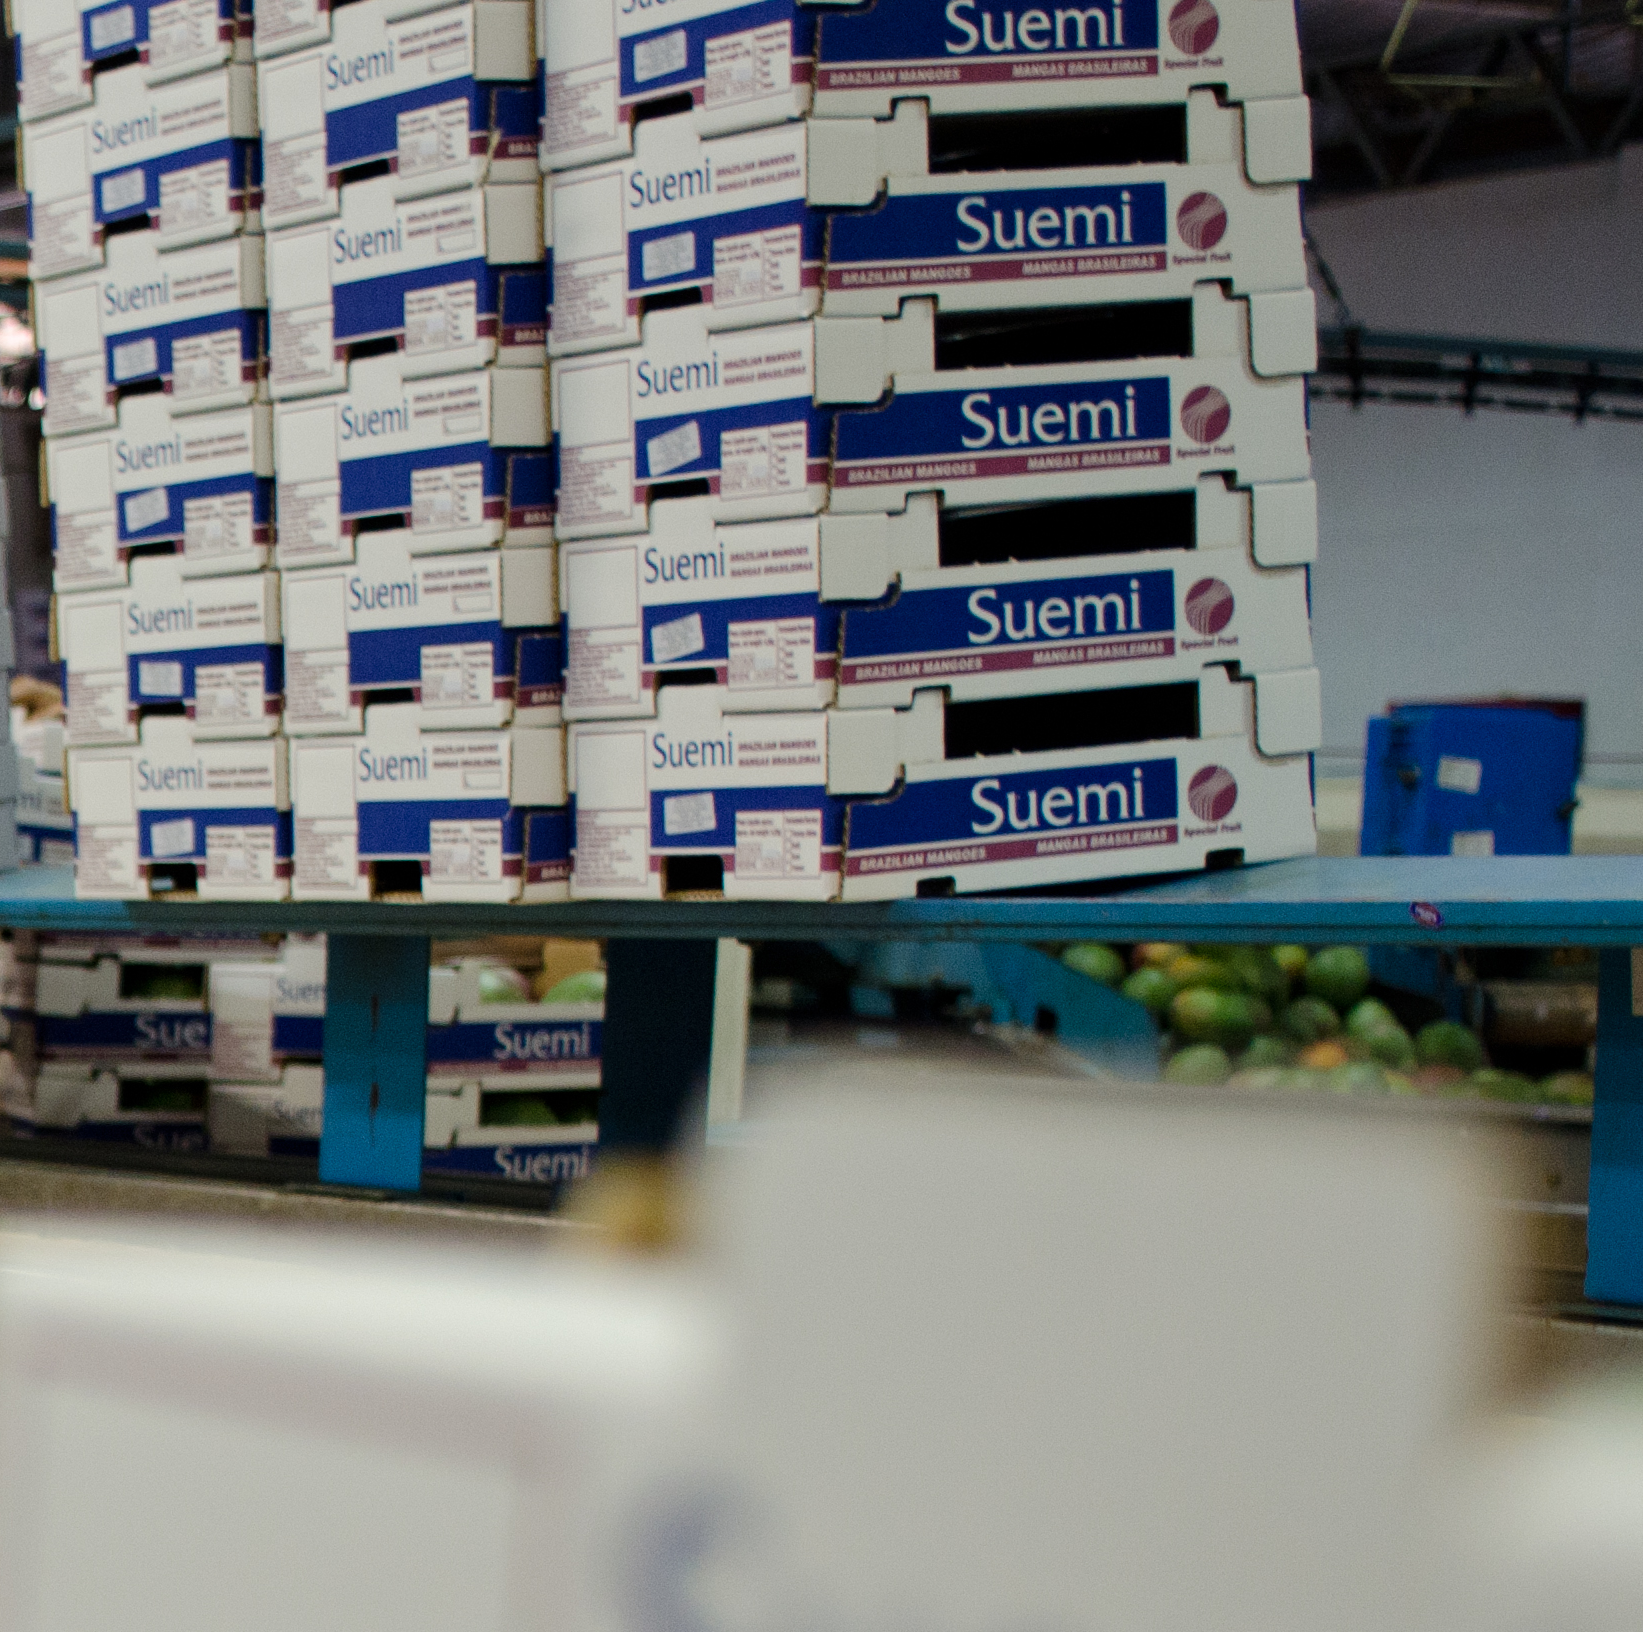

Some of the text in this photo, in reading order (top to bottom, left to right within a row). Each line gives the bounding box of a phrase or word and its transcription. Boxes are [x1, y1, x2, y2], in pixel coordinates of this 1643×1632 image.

[945, 0, 1125, 55] Suemi
[326, 40, 395, 90] Suemi
[91, 107, 159, 155] Suemi
[629, 157, 712, 209] Suemi
[333, 214, 403, 263] Suemi
[956, 190, 1134, 253] Suemi
[103, 270, 170, 316] Suemi
[636, 352, 719, 398] Suemi
[339, 398, 409, 442] Suemi
[961, 384, 1137, 449] Suemi
[116, 435, 182, 473] Suemi
[644, 542, 726, 584] Suemi
[349, 573, 419, 612] Suemi
[967, 578, 1143, 645] Suemi
[128, 600, 193, 635] Suemi
[358, 743, 428, 782] Suemi
[652, 731, 734, 769] Suemi
[137, 758, 203, 792] Suemi
[971, 767, 1145, 835] Suemi
[135, 1013, 208, 1049] Sue
[493, 1022, 591, 1059] Suemi
[494, 1144, 591, 1182] Suemi
